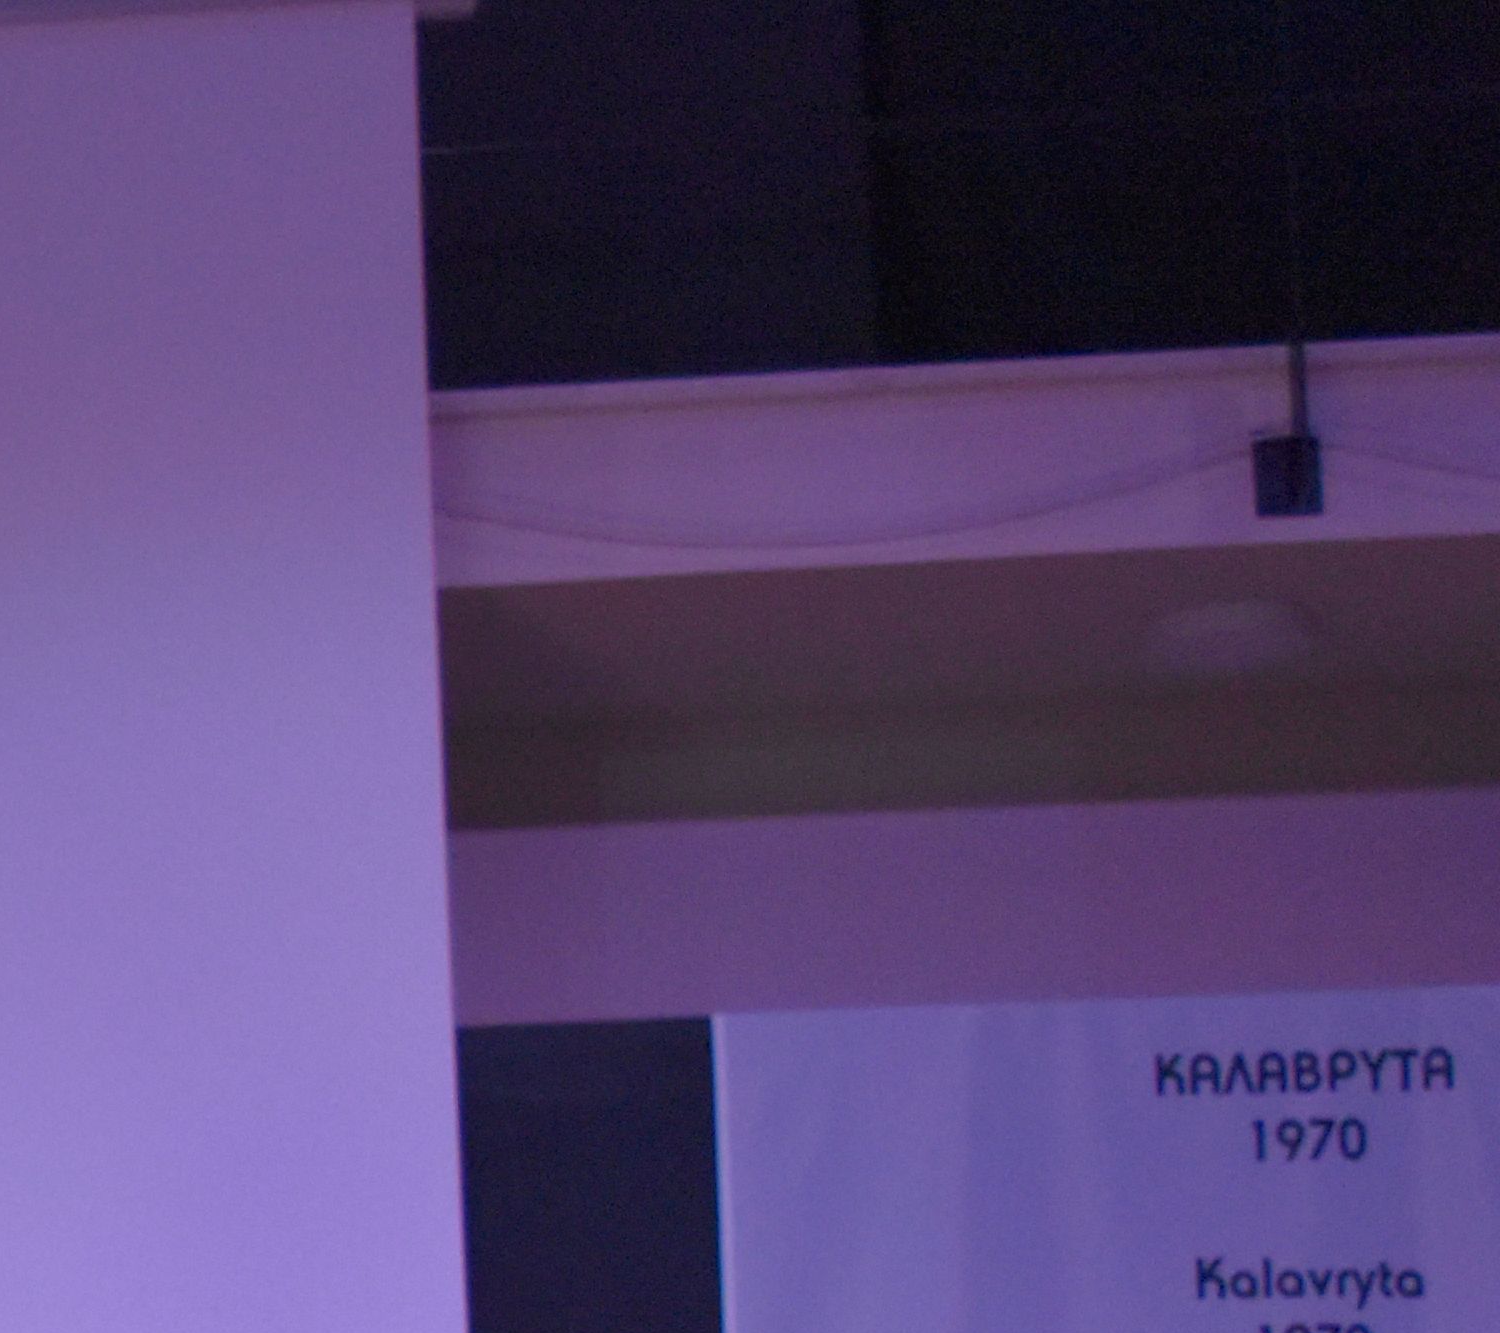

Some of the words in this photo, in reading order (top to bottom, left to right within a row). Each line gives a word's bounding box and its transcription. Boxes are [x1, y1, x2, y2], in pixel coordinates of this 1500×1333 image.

[1153, 1046, 1456, 1096] ΚΑΛΑΒΡΥΤΑ
[1252, 1117, 1368, 1161] 1970
[1194, 1256, 1426, 1310] Kalavryta
